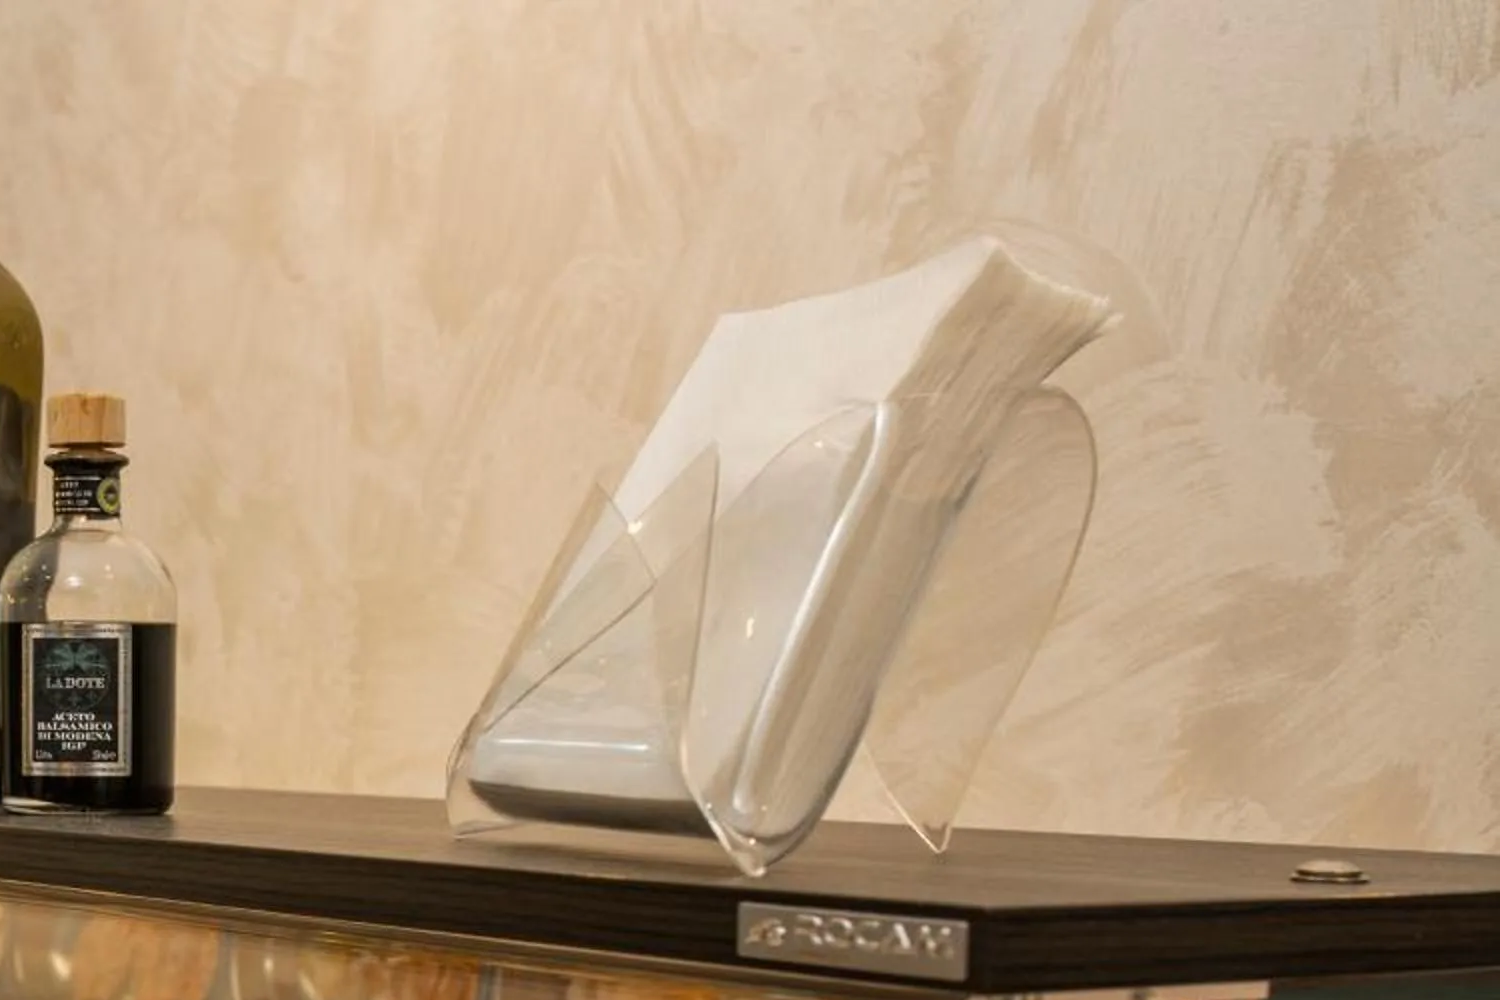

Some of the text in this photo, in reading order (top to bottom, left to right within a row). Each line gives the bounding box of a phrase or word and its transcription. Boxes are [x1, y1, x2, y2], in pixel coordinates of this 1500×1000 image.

[45, 676, 106, 689] LA DOTE
[51, 712, 96, 721] ACETO
[36, 721, 114, 731] BALSAMICO
[37, 731, 112, 742] DI MODENA
